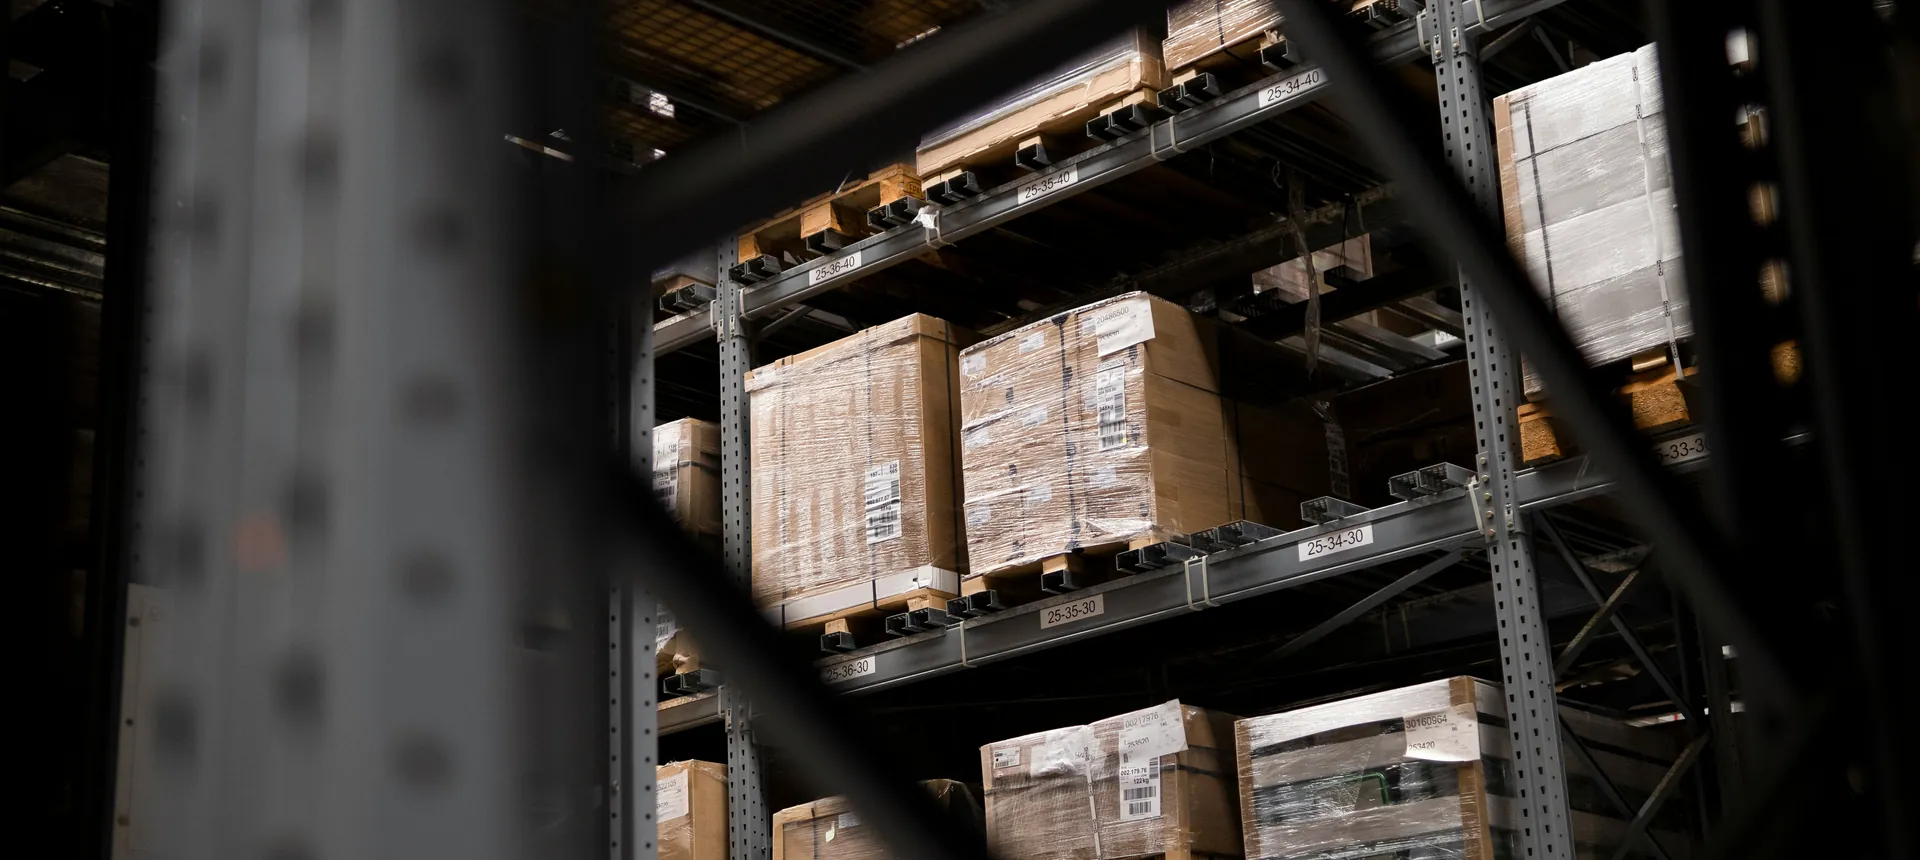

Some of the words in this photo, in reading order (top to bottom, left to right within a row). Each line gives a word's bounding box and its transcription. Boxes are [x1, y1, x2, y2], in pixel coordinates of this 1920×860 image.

[1267, 70, 1320, 102] 25-34-40
[1024, 171, 1070, 199] 25-35-40
[815, 256, 855, 281] 25-36-40
[1307, 529, 1363, 556] 25-34-30
[1048, 600, 1095, 624] 25-35-30
[826, 660, 869, 681] 25-36-30
